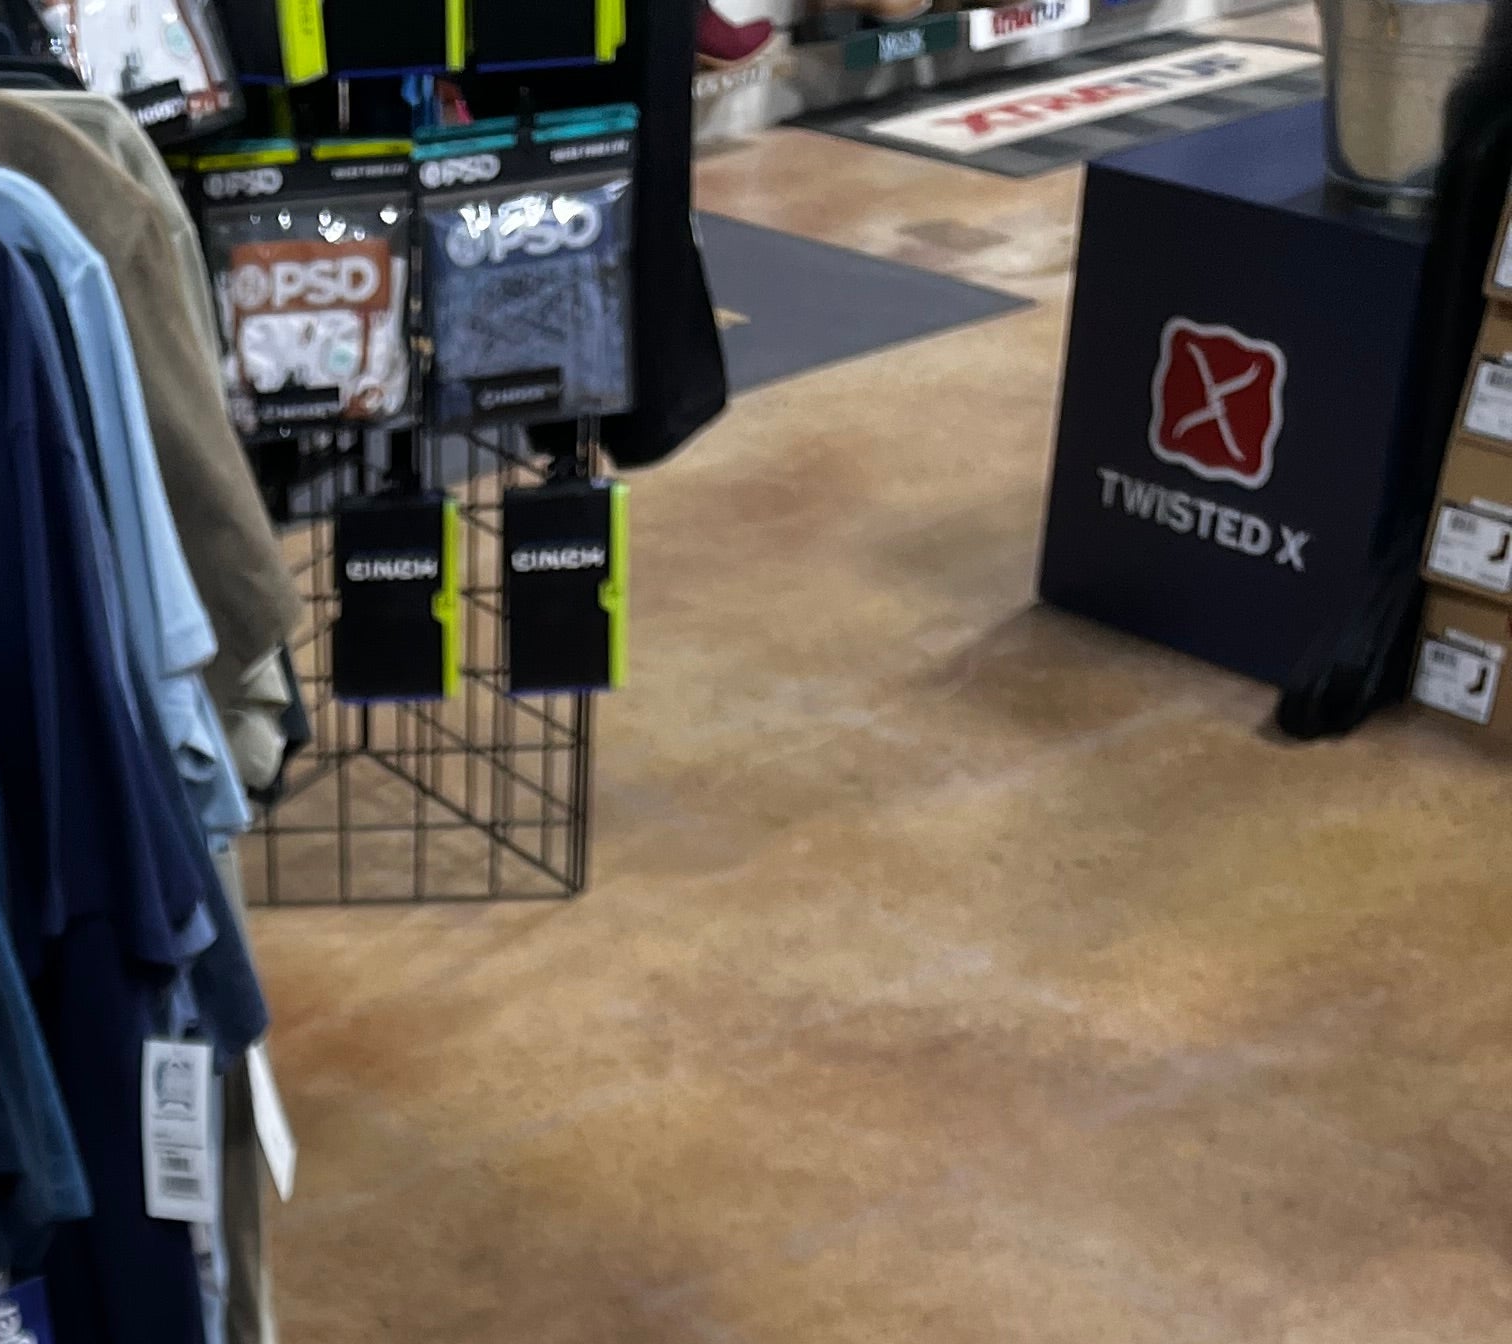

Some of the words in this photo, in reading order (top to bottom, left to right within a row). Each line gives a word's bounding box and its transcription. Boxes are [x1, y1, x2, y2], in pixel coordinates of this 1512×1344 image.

[487, 199, 602, 264] PSD
[270, 255, 381, 308] PSD
[1096, 466, 1272, 556] TWISTED
[1275, 524, 1311, 573] X
